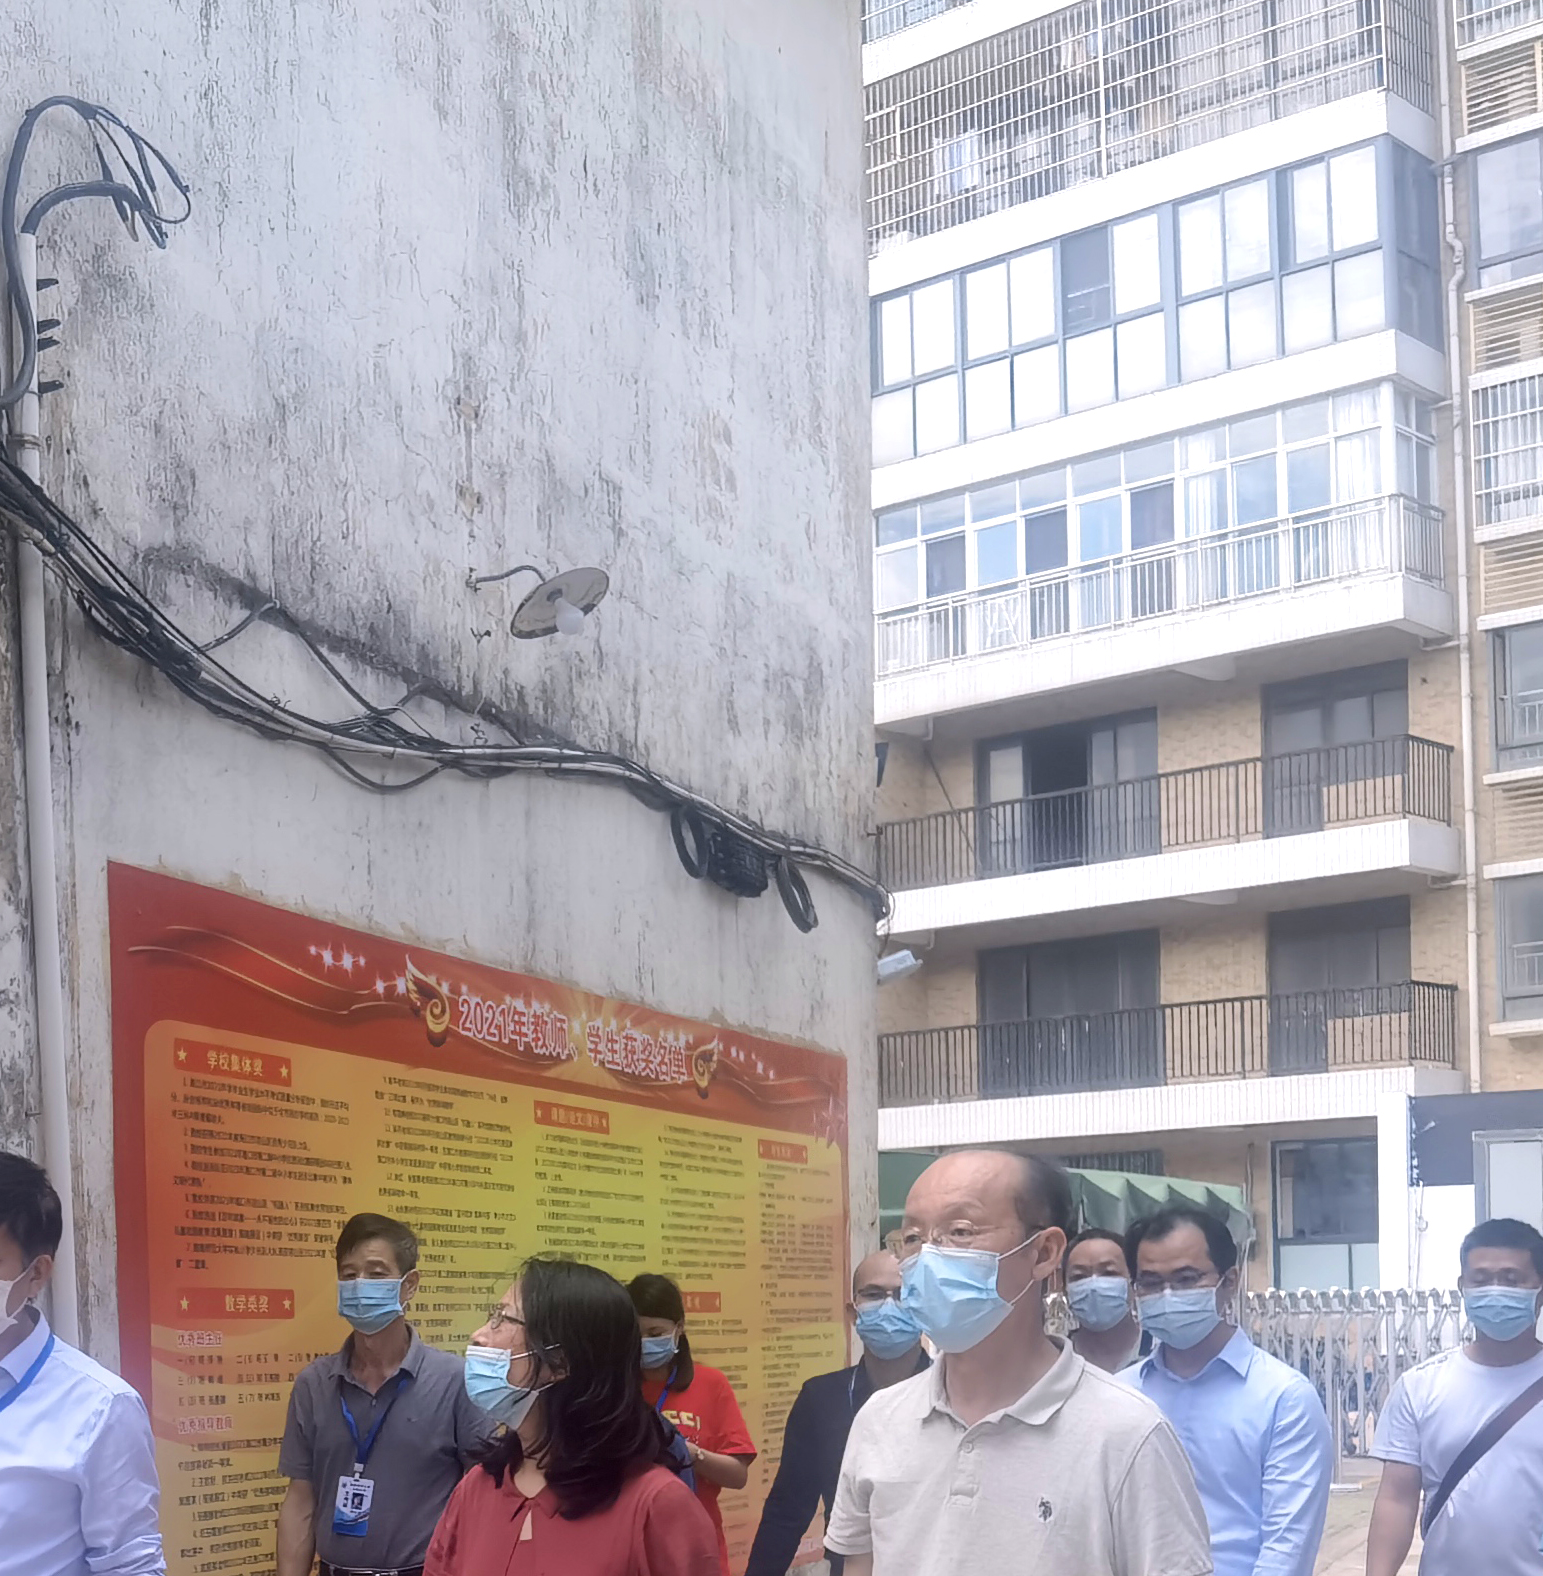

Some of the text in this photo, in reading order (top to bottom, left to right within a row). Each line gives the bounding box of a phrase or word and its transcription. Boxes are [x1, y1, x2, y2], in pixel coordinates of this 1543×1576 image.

[206, 1050, 264, 1077] 学校集体奖
[458, 995, 688, 1083] 2021年教师、学生获奖名单
